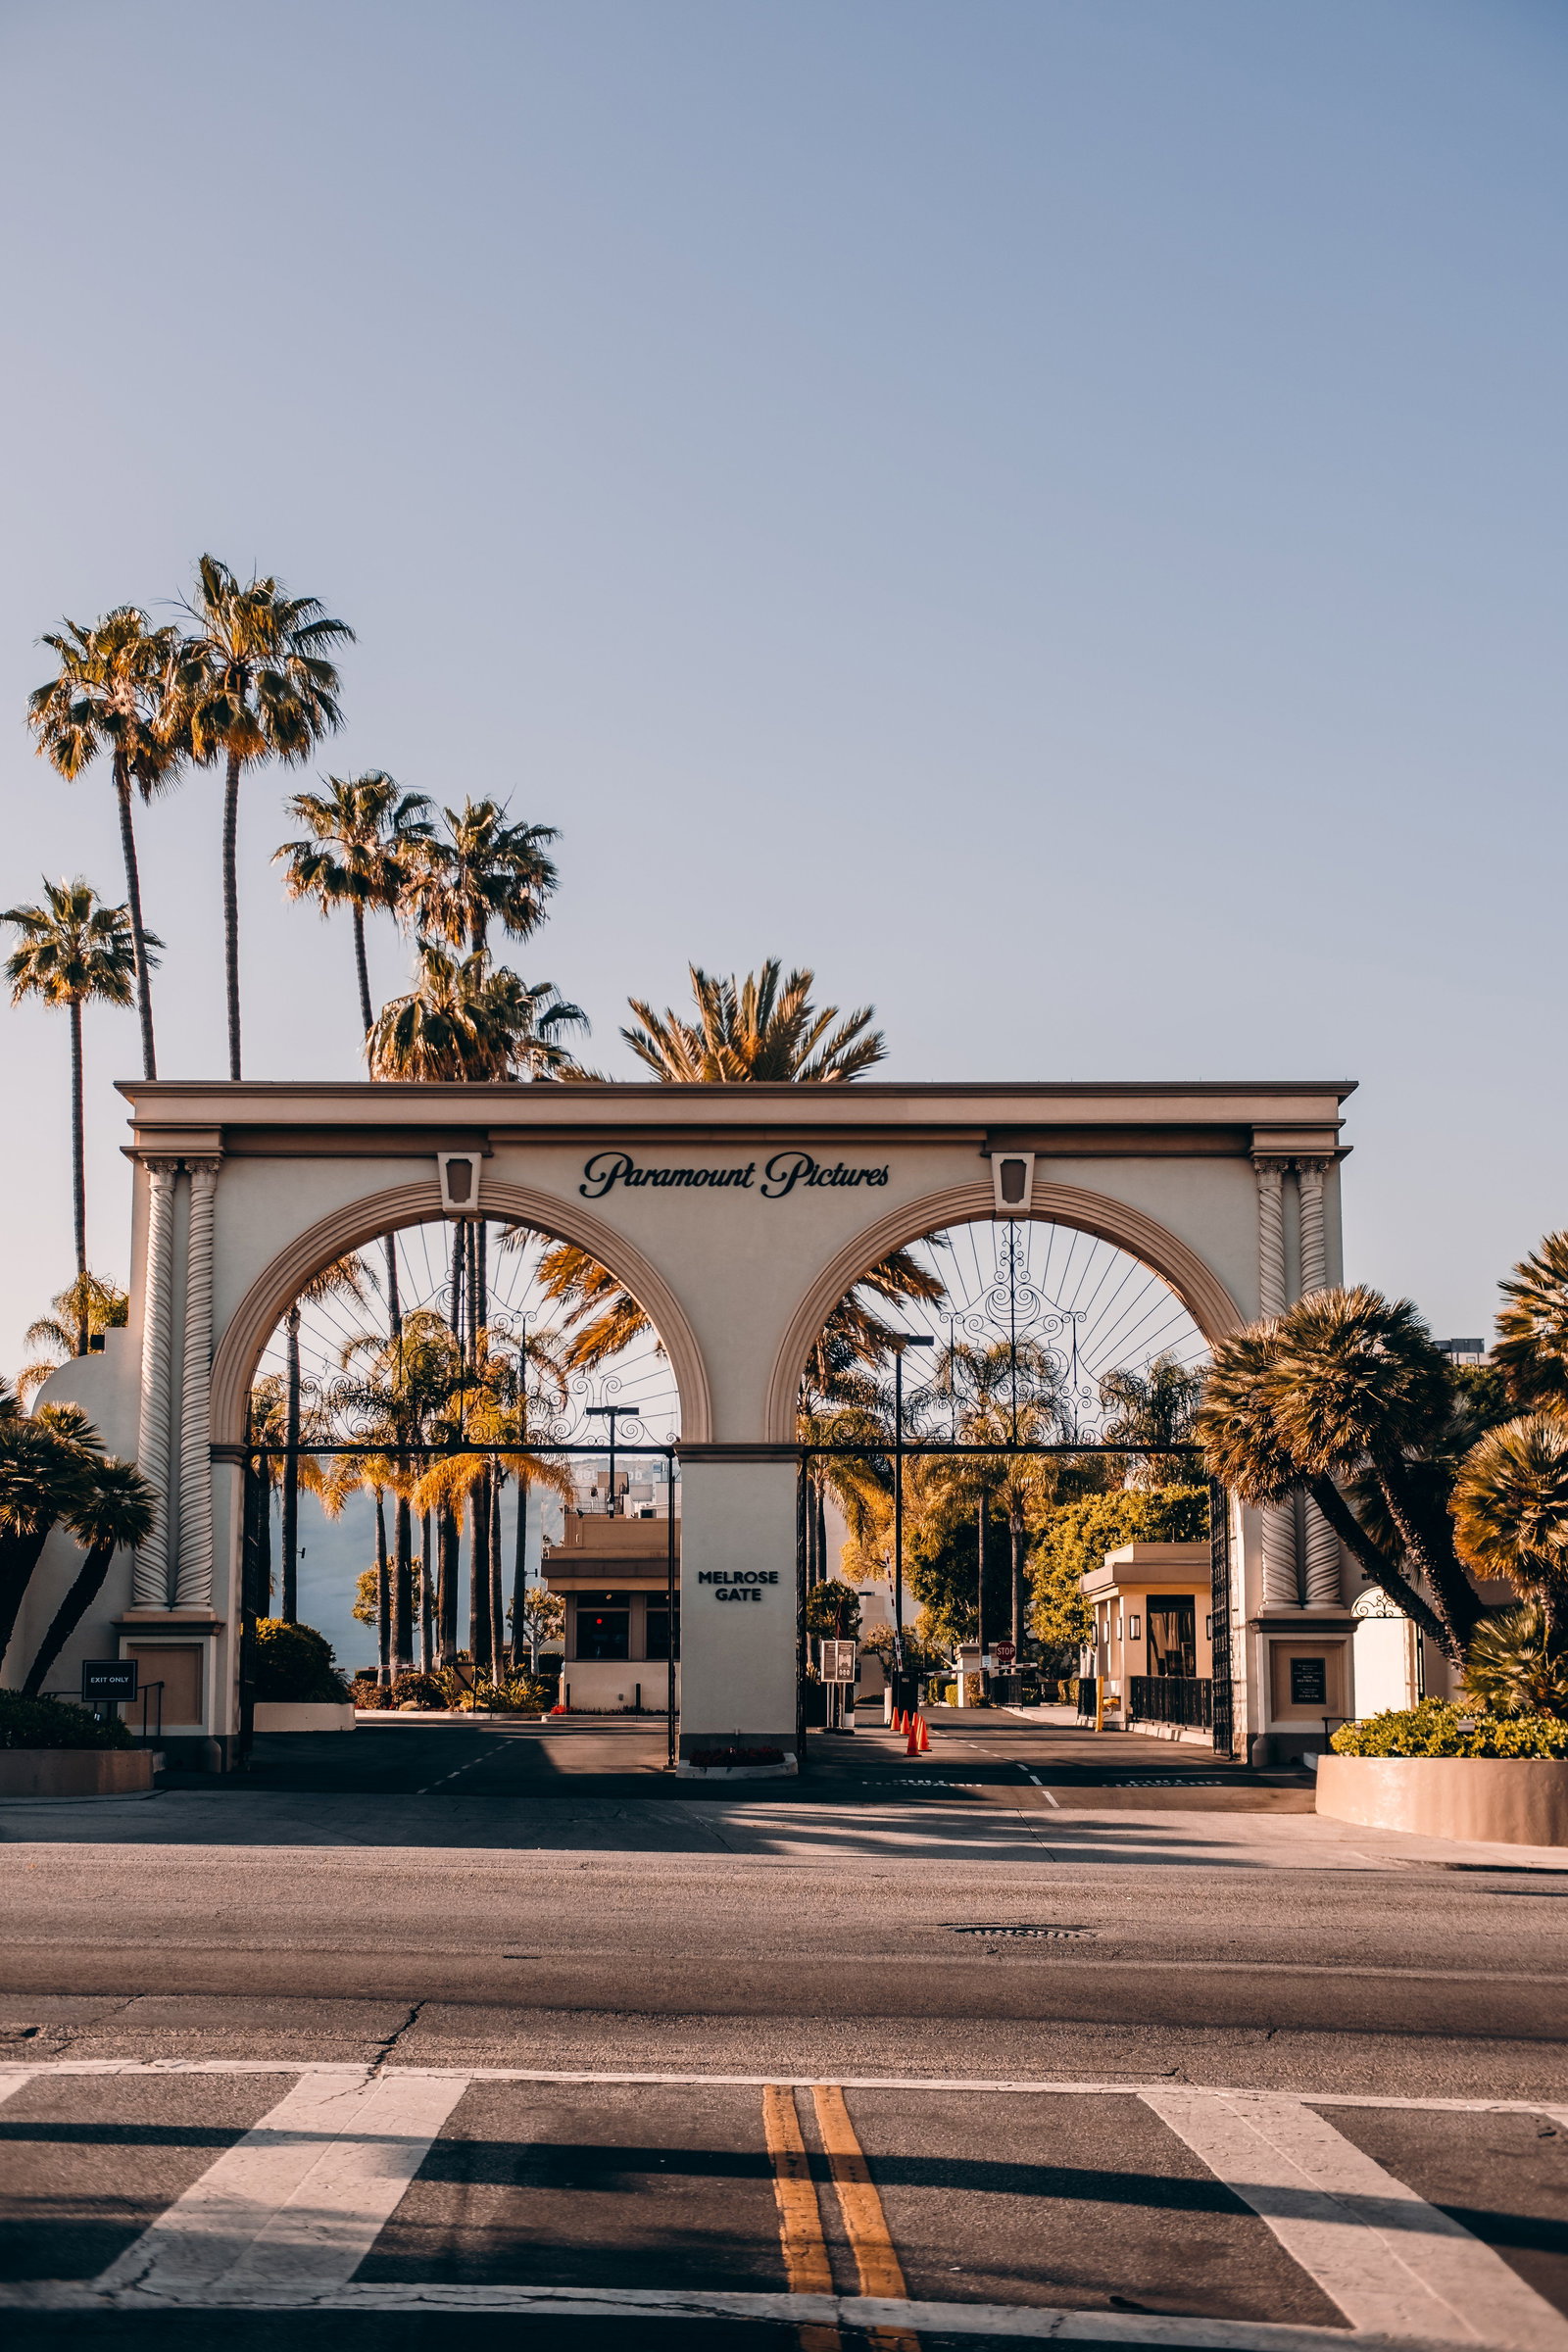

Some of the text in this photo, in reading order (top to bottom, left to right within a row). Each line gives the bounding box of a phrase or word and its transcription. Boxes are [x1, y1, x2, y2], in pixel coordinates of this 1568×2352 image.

[579, 1152, 889, 1199] Paramount Pictures
[575, 1470, 643, 1481] HOLOD
[699, 1571, 779, 1585] MELROSE
[715, 1588, 761, 1601] GATE
